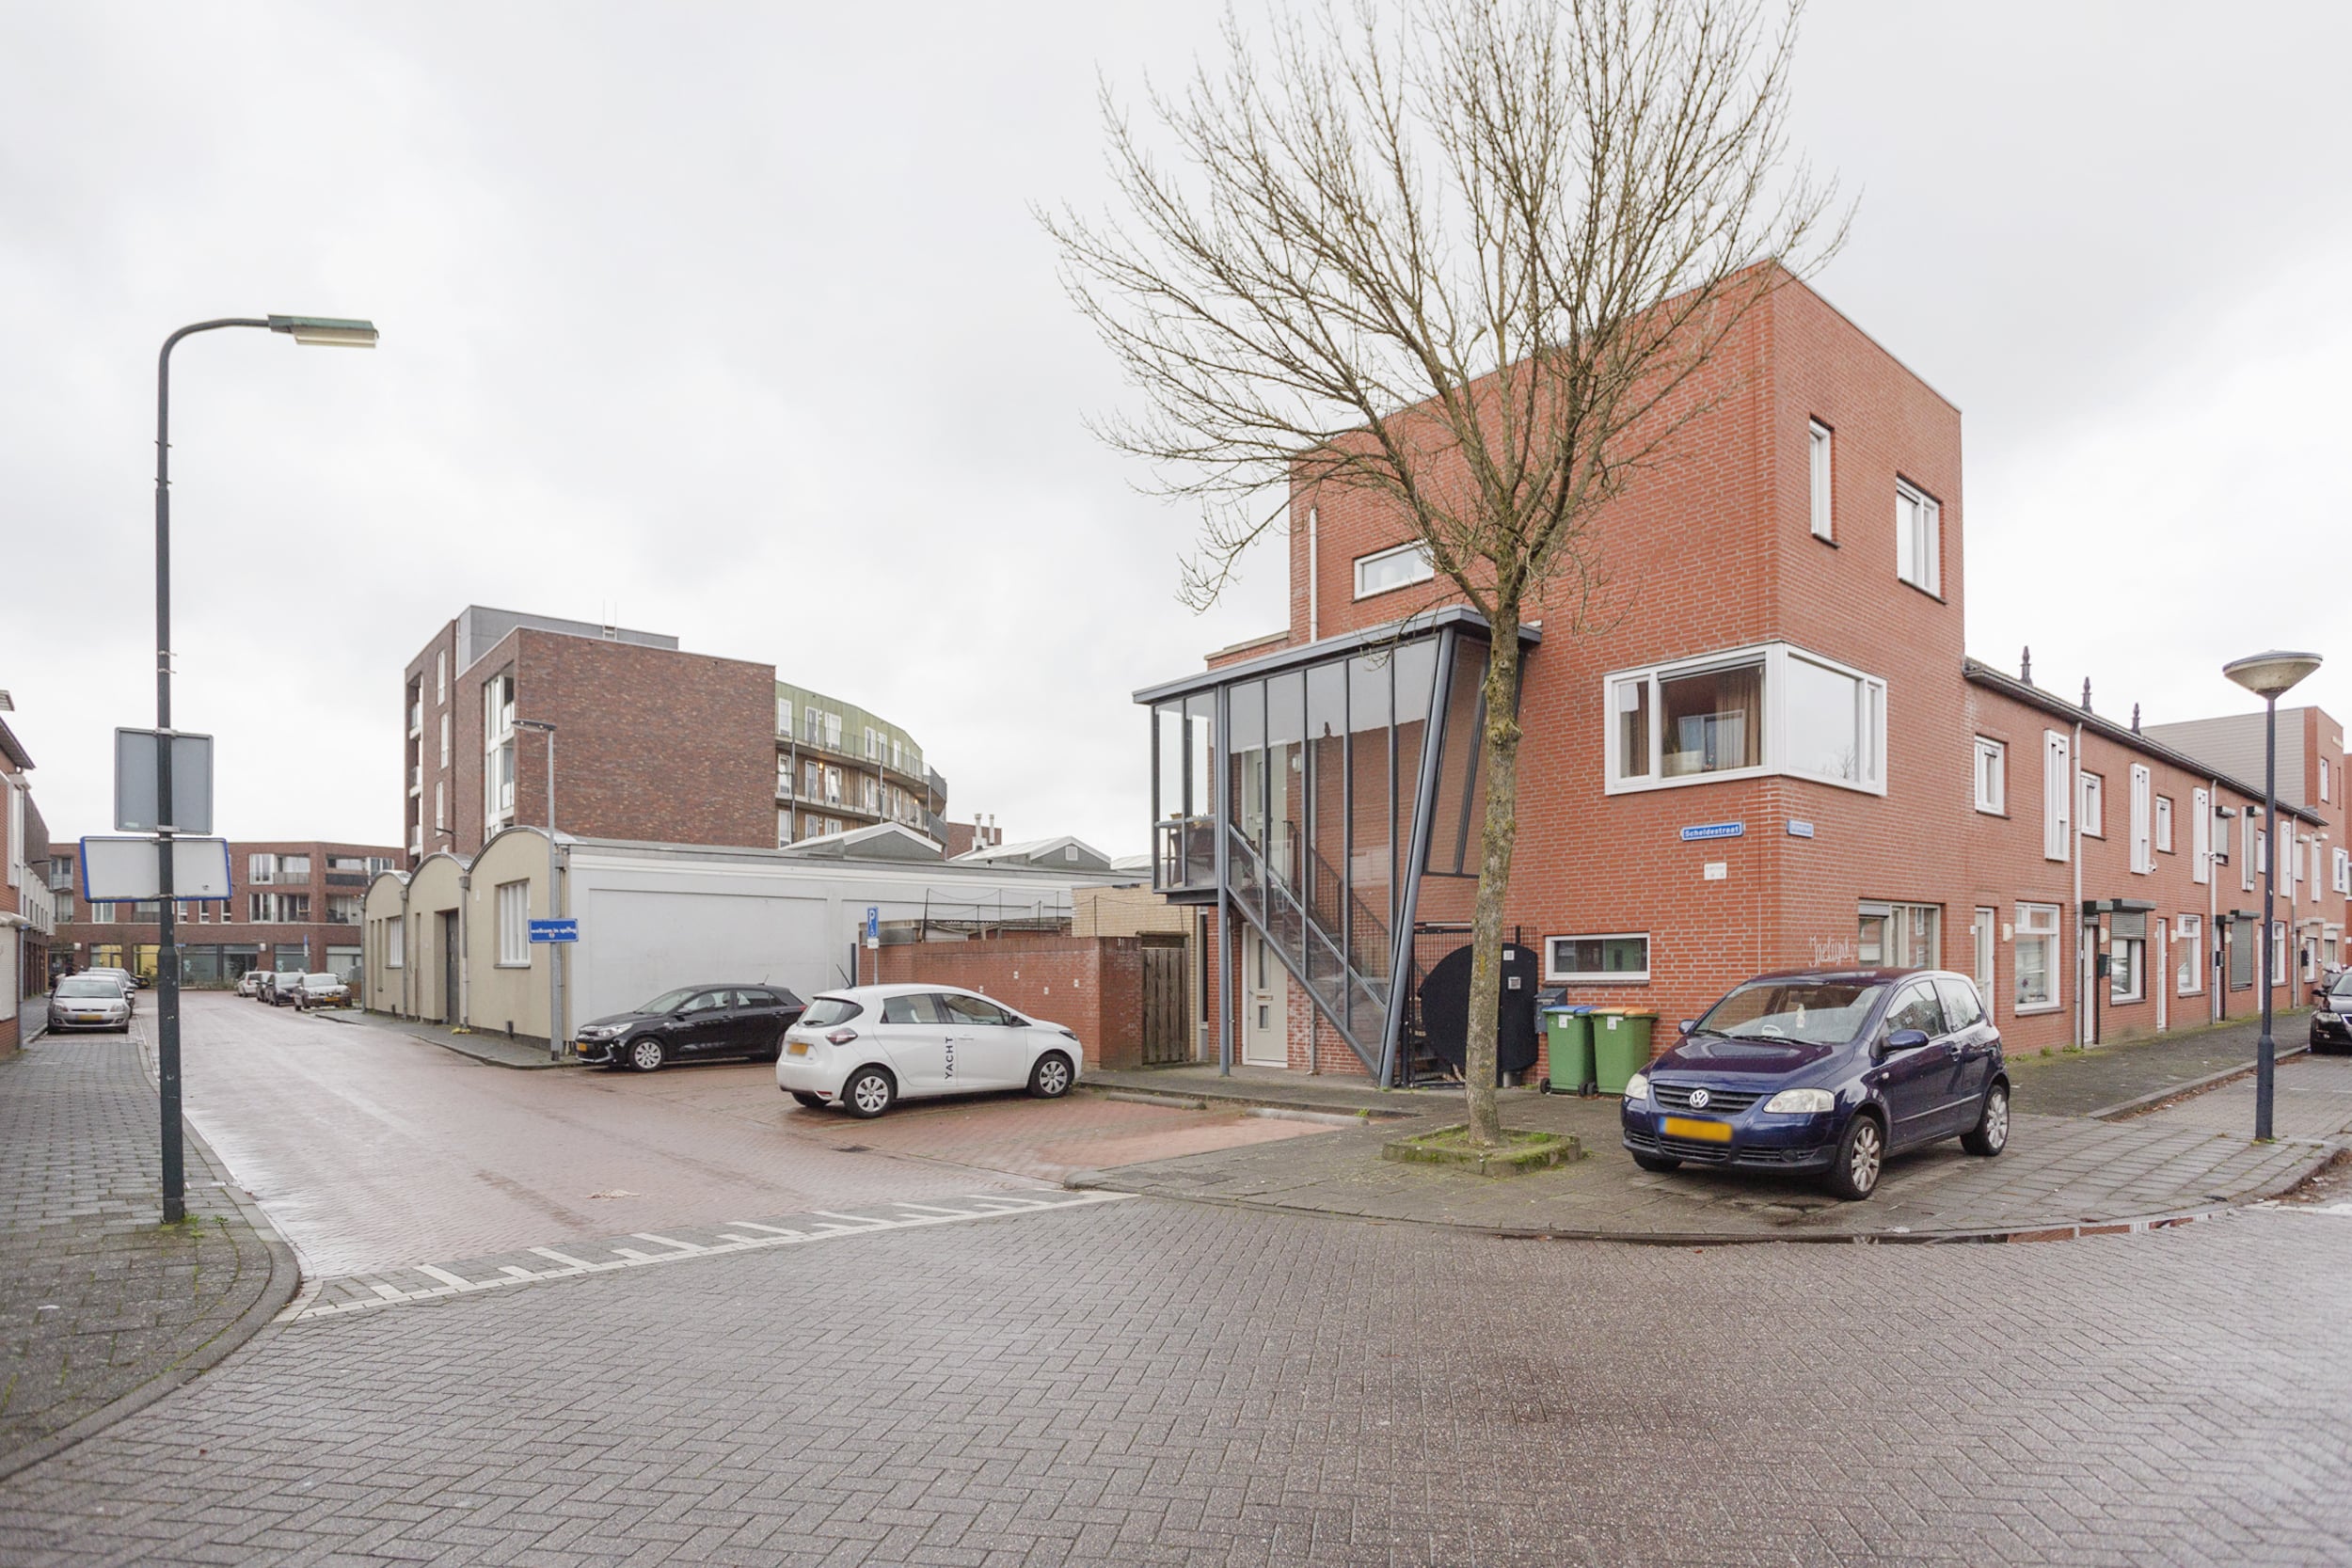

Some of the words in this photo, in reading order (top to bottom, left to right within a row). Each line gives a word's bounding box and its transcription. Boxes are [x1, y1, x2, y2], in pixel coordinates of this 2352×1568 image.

[1684, 825, 1740, 838] Scheldestraat
[868, 910, 876, 925] P
[944, 1036, 954, 1080] YACHT
